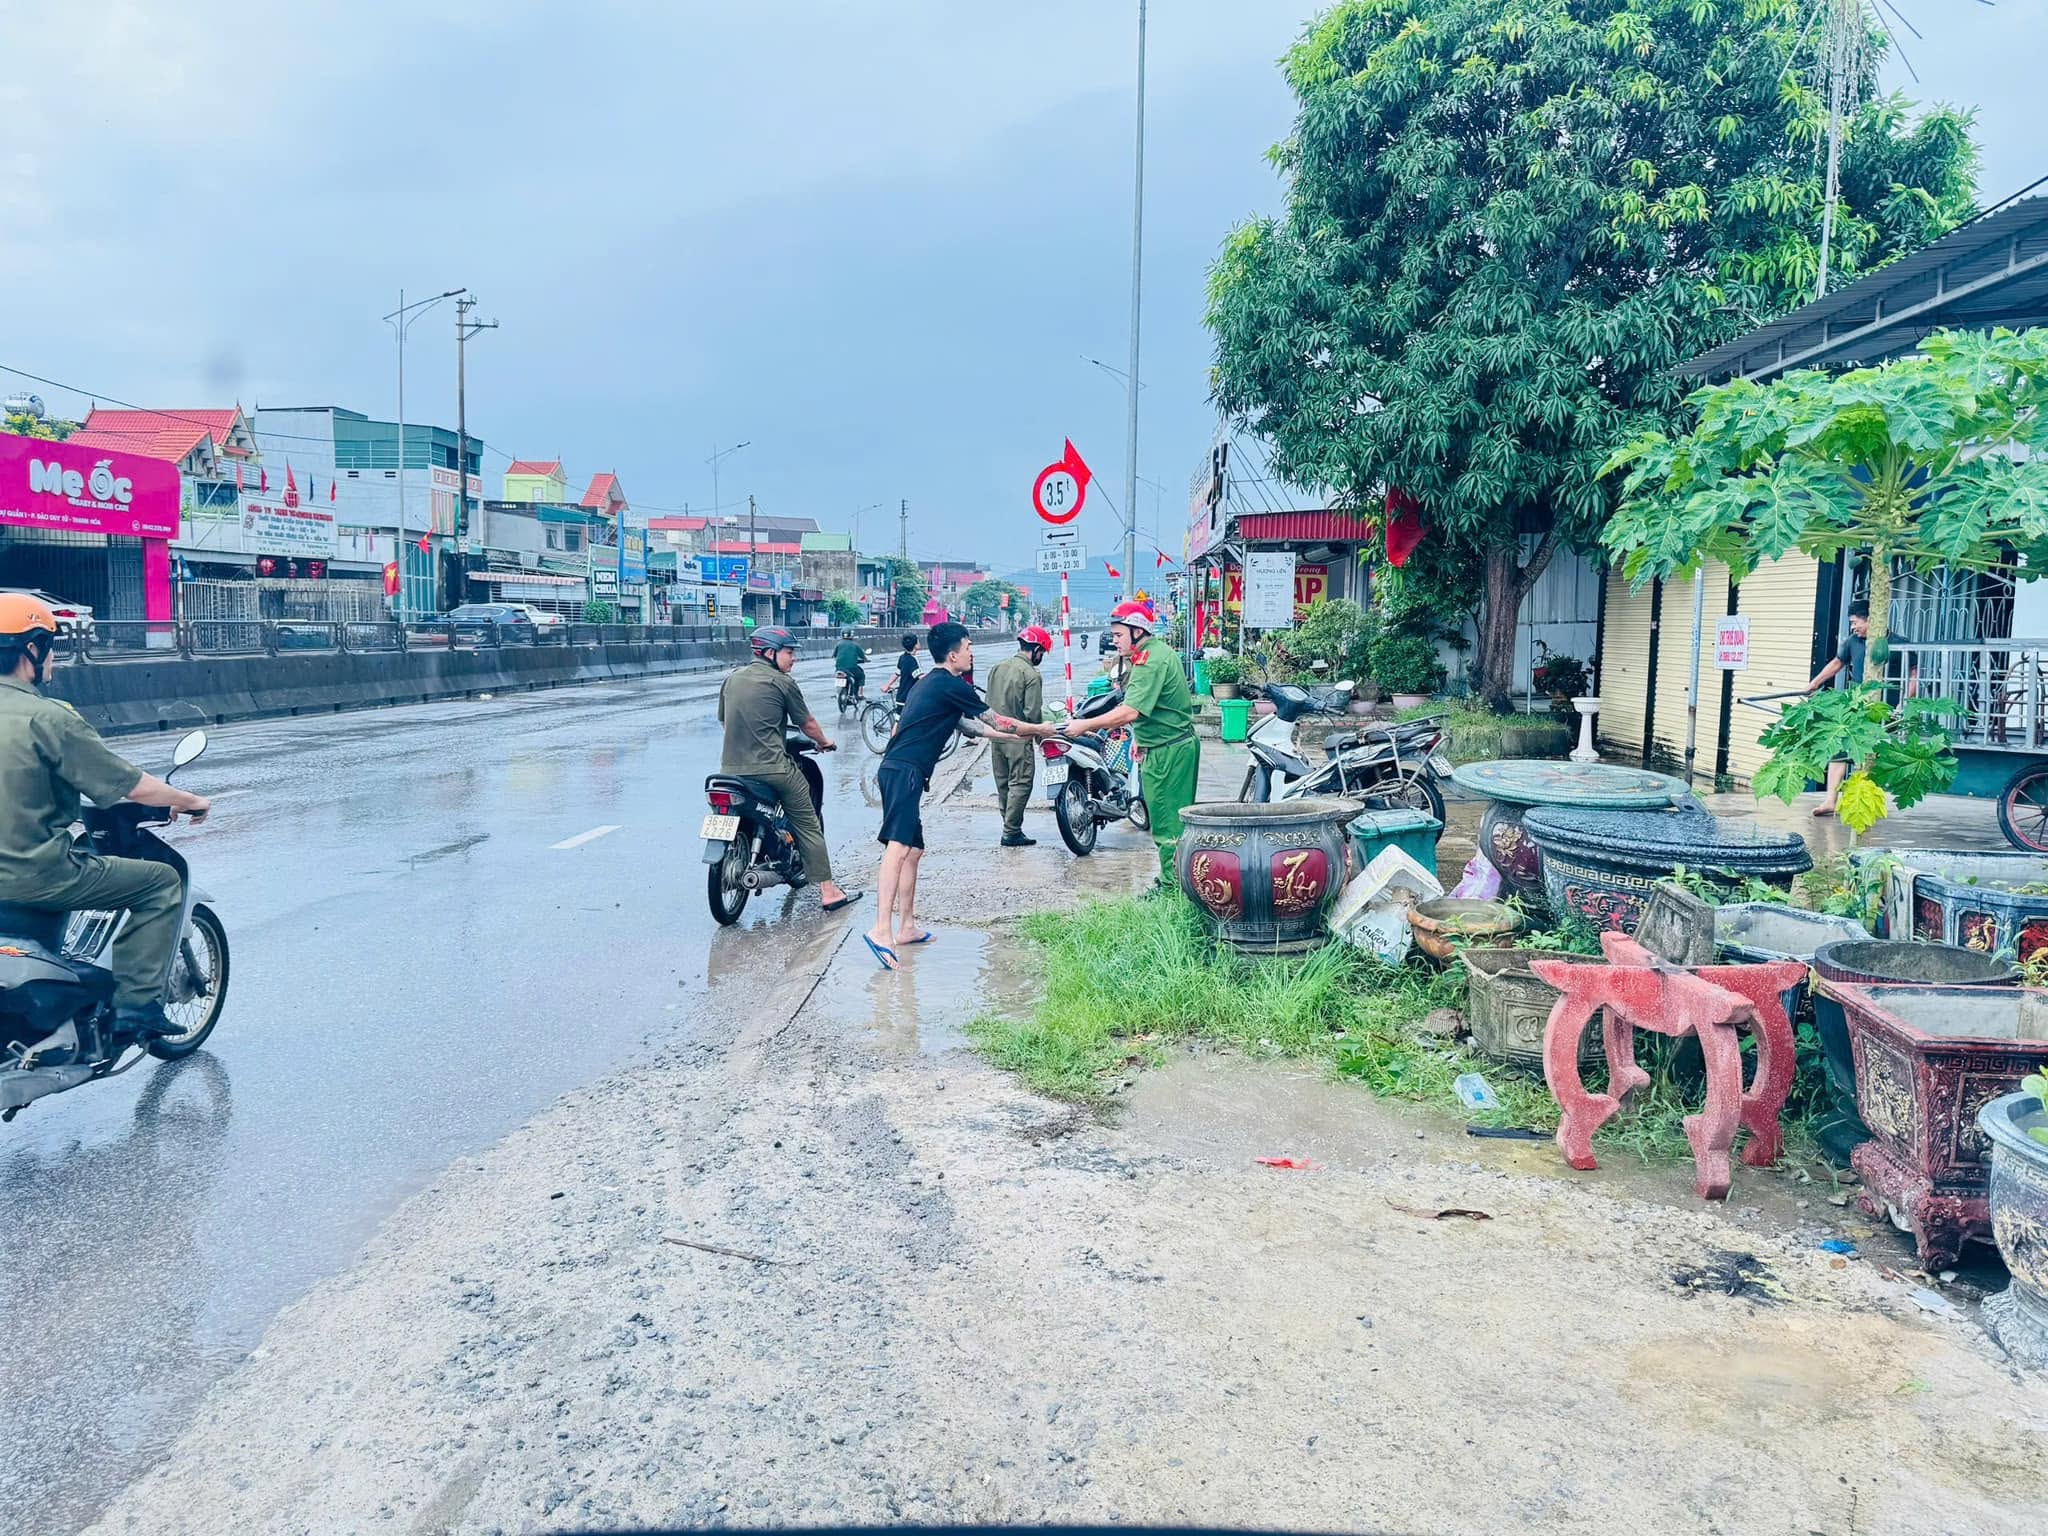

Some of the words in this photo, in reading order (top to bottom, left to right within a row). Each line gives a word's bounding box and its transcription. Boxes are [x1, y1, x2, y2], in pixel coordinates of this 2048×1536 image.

[88, 459, 133, 504] Ốc
[1046, 481, 1064, 506] 3.5
[595, 572, 615, 582] NEM
[595, 583, 618, 594] CHUA
